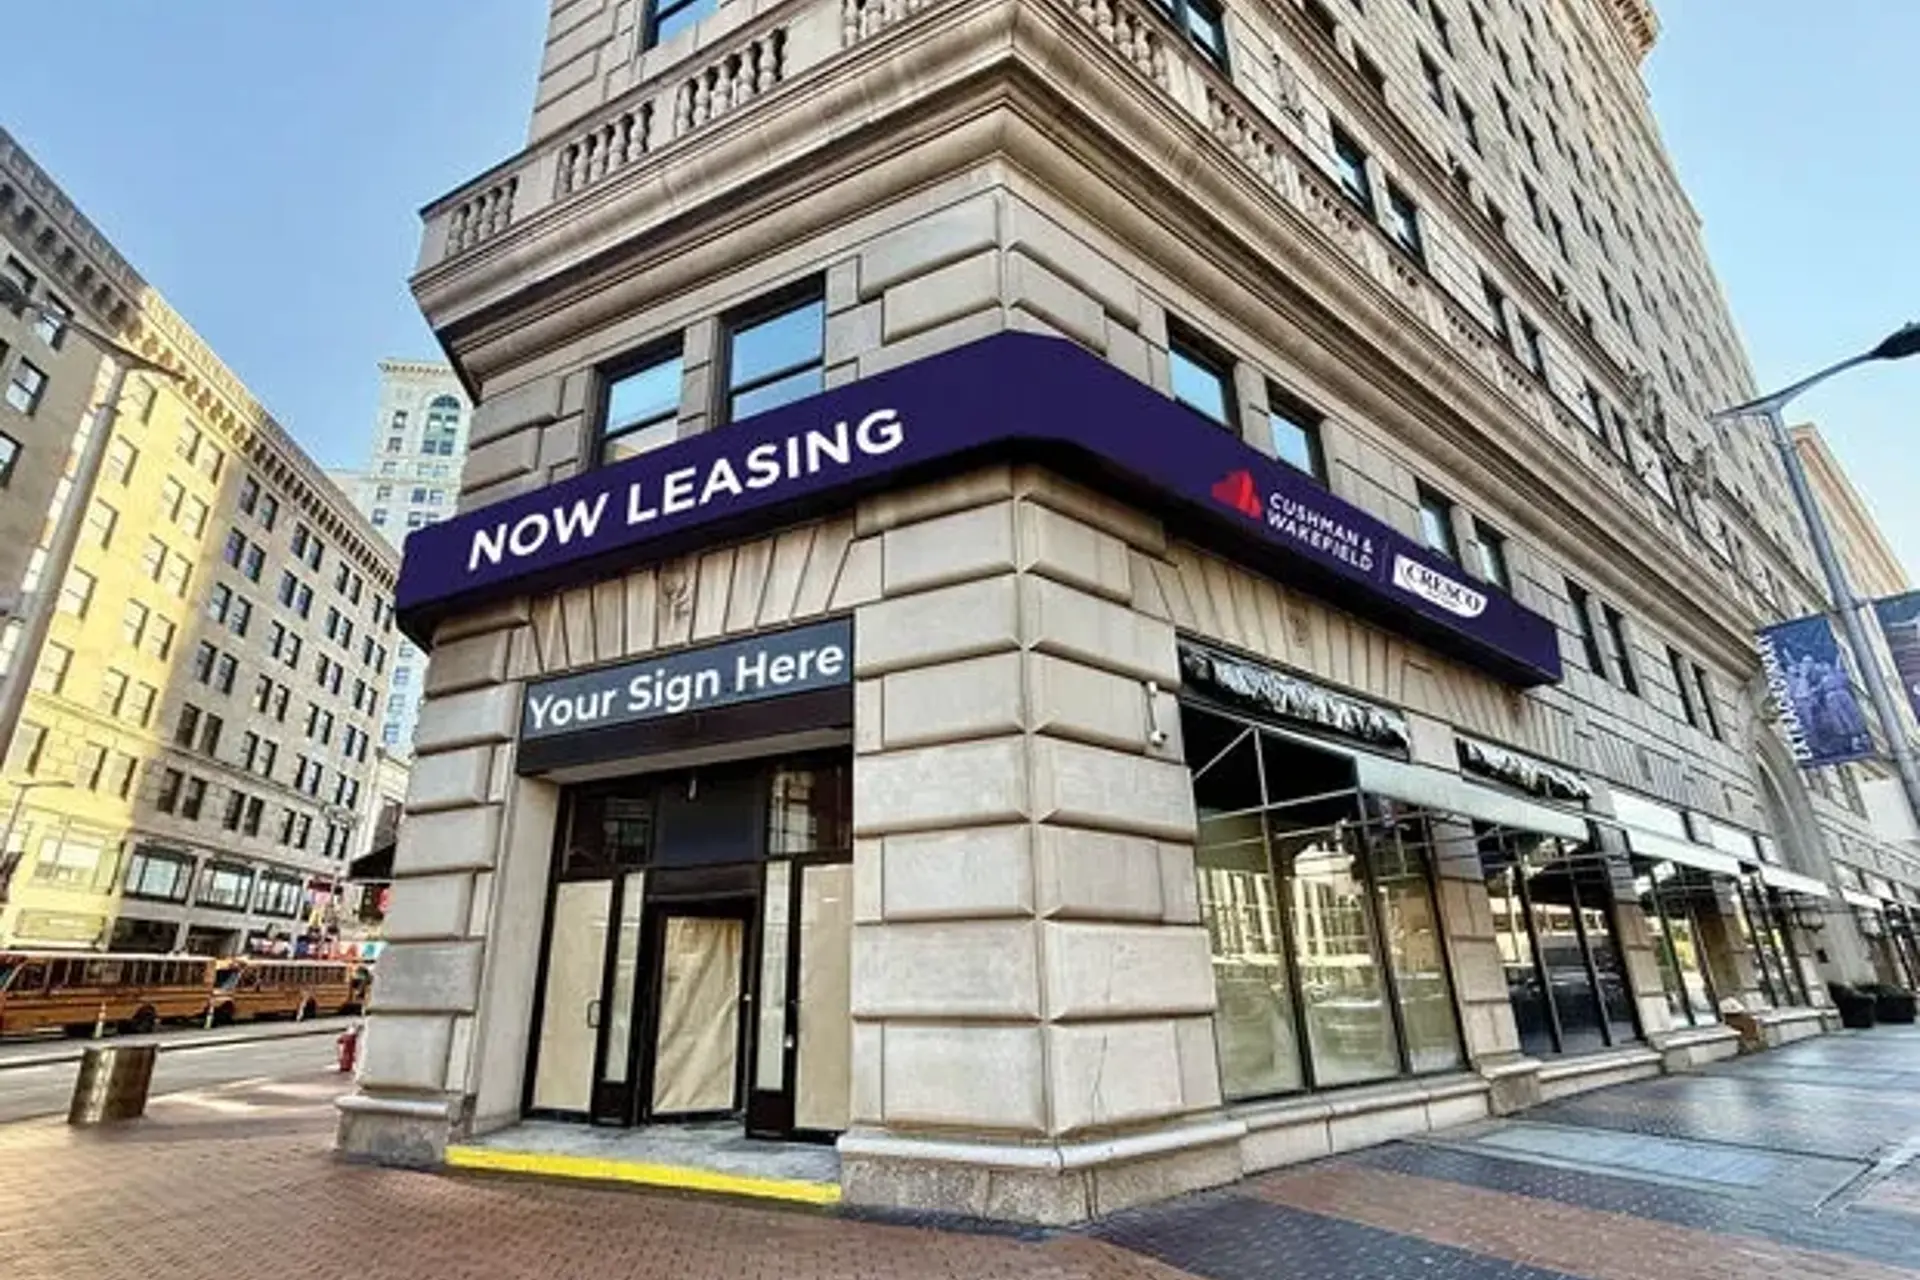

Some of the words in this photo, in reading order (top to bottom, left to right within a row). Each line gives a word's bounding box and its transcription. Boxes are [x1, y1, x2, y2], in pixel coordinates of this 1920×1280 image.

[469, 493, 609, 570] NOW
[627, 409, 903, 525] LEASING
[1269, 491, 1360, 548] CUSHMAN
[1362, 537, 1374, 555] &
[1266, 508, 1375, 573] WAKEFIELD
[528, 689, 618, 730] Your
[627, 667, 721, 714] Sign
[736, 645, 845, 692] Here
